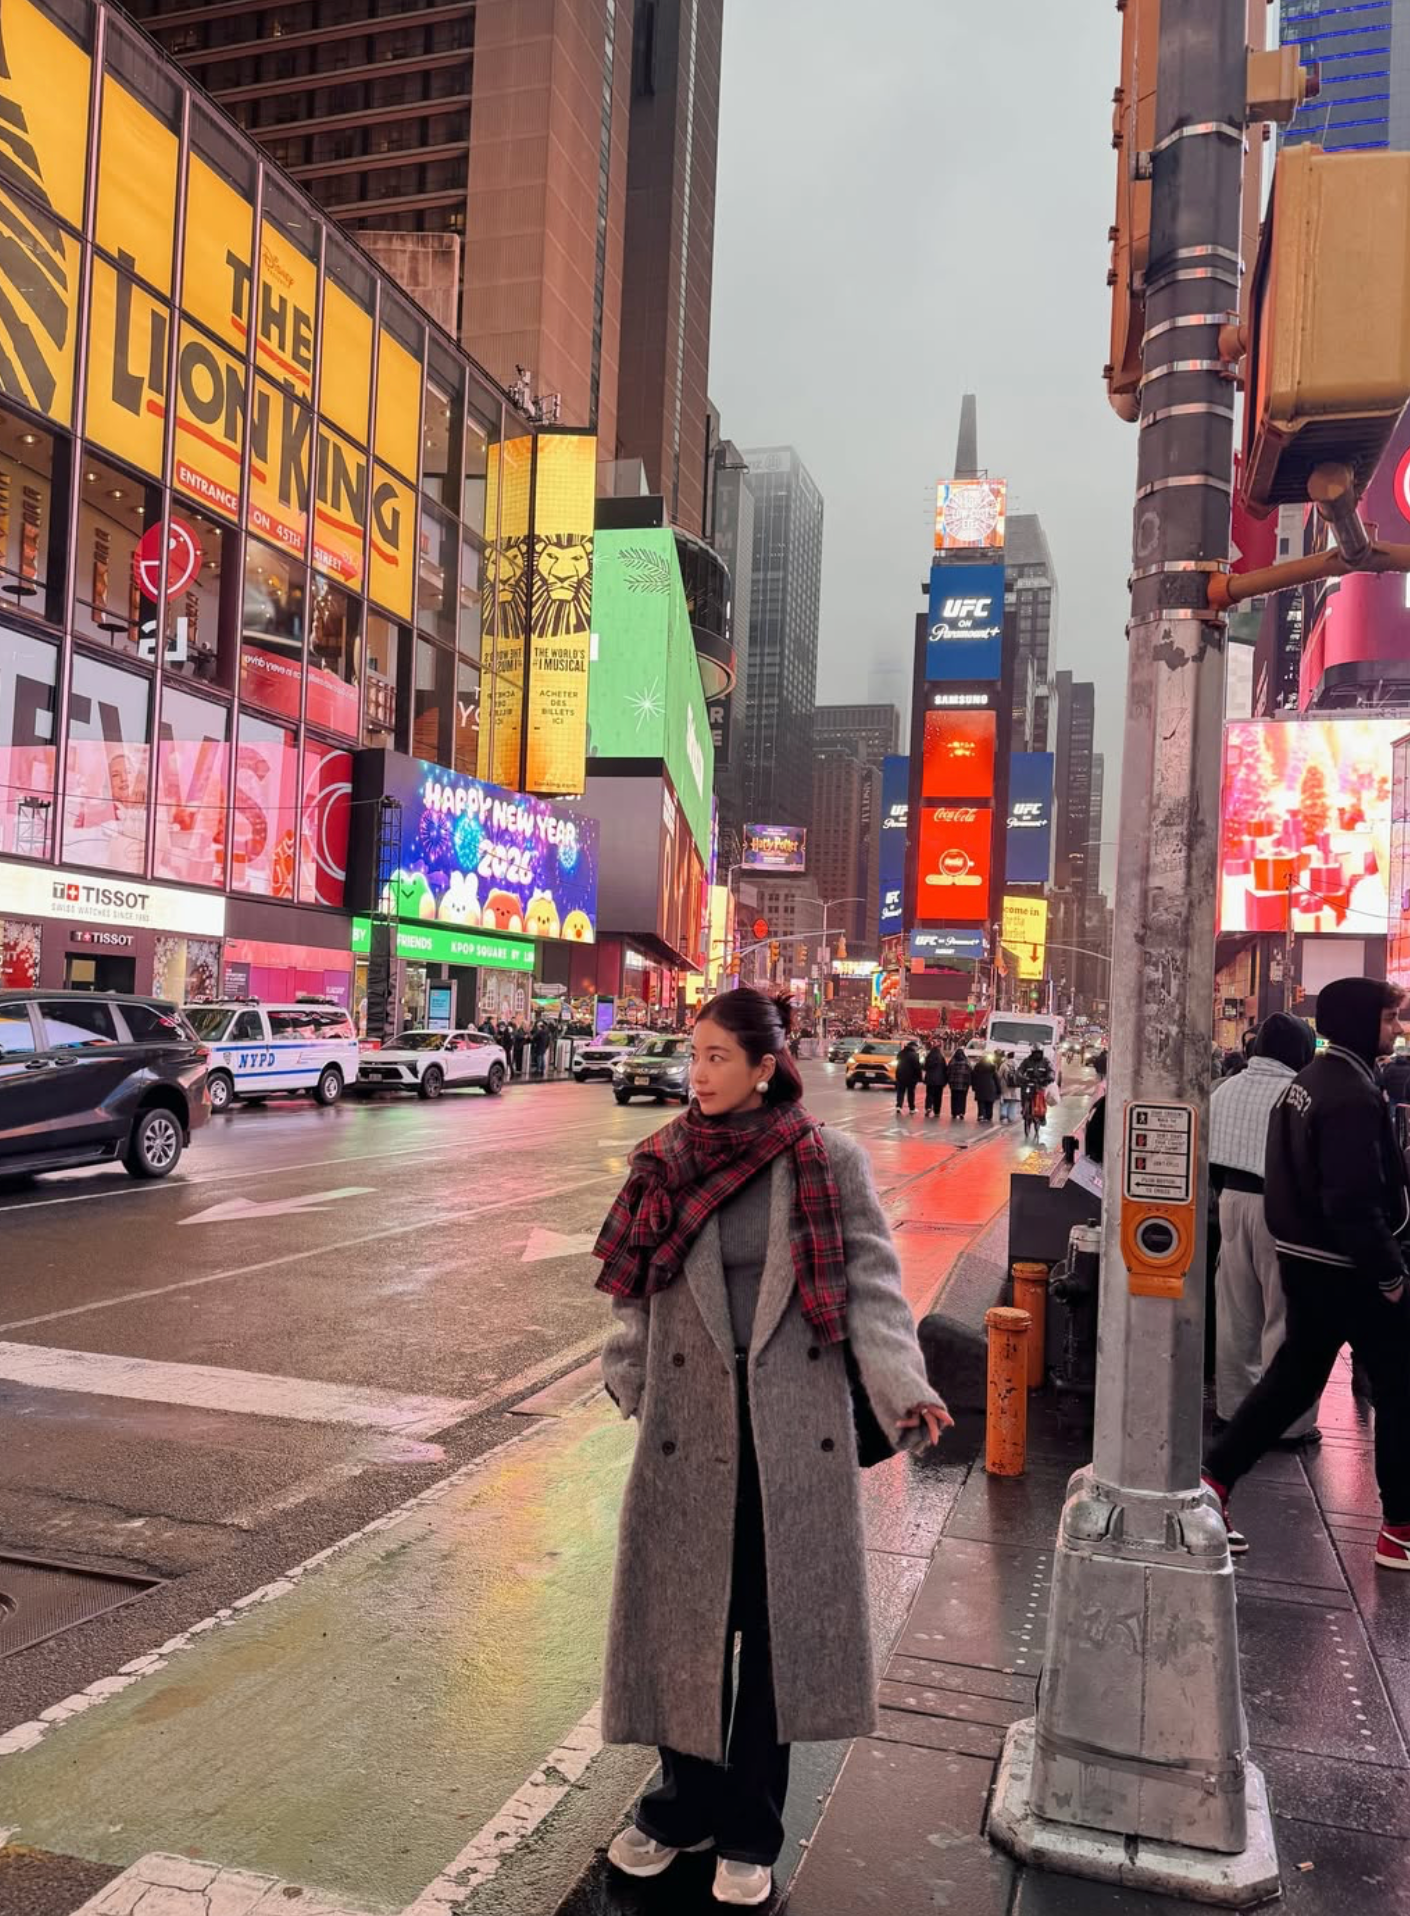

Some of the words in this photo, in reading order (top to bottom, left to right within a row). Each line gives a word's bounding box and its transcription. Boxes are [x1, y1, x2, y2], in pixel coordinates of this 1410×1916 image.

[226, 249, 313, 373] THE
[112, 247, 270, 464] LION
[279, 377, 400, 551] KING
[180, 467, 238, 510] ENTRANCE
[253, 511, 270, 530] ON
[276, 525, 301, 547] 45TH
[314, 547, 342, 571] STREET
[943, 598, 992, 617] UFC
[958, 620, 973, 628] ON
[534, 648, 549, 657] THE
[551, 648, 585, 658] WORLD'S
[543, 658, 586, 672] MUSICAL
[539, 690, 578, 698] ACHETER
[934, 694, 988, 705] SAMSUNG
[541, 708, 575, 716] BILLETS
[423, 780, 492, 824] HAPPY
[493, 800, 534, 837] NEW
[536, 814, 576, 846] YEAR
[890, 804, 909, 816] UF
[1013, 803, 1043, 815] UFC
[477, 839, 535, 885] 2026
[82, 886, 150, 910] TISSOT
[51, 902, 75, 912] SWISS
[78, 906, 110, 918] WATCHES
[113, 910, 133, 920] SINCE
[1029, 907, 1040, 916] in
[91, 931, 134, 946] TISSOT
[353, 928, 366, 941] BY
[915, 935, 938, 946] UFC
[397, 933, 432, 950] FRIENDS
[451, 941, 474, 954] KPOP
[477, 945, 507, 960] SQUARE
[511, 949, 520, 961] BY
[238, 1053, 275, 1068] NYPD
